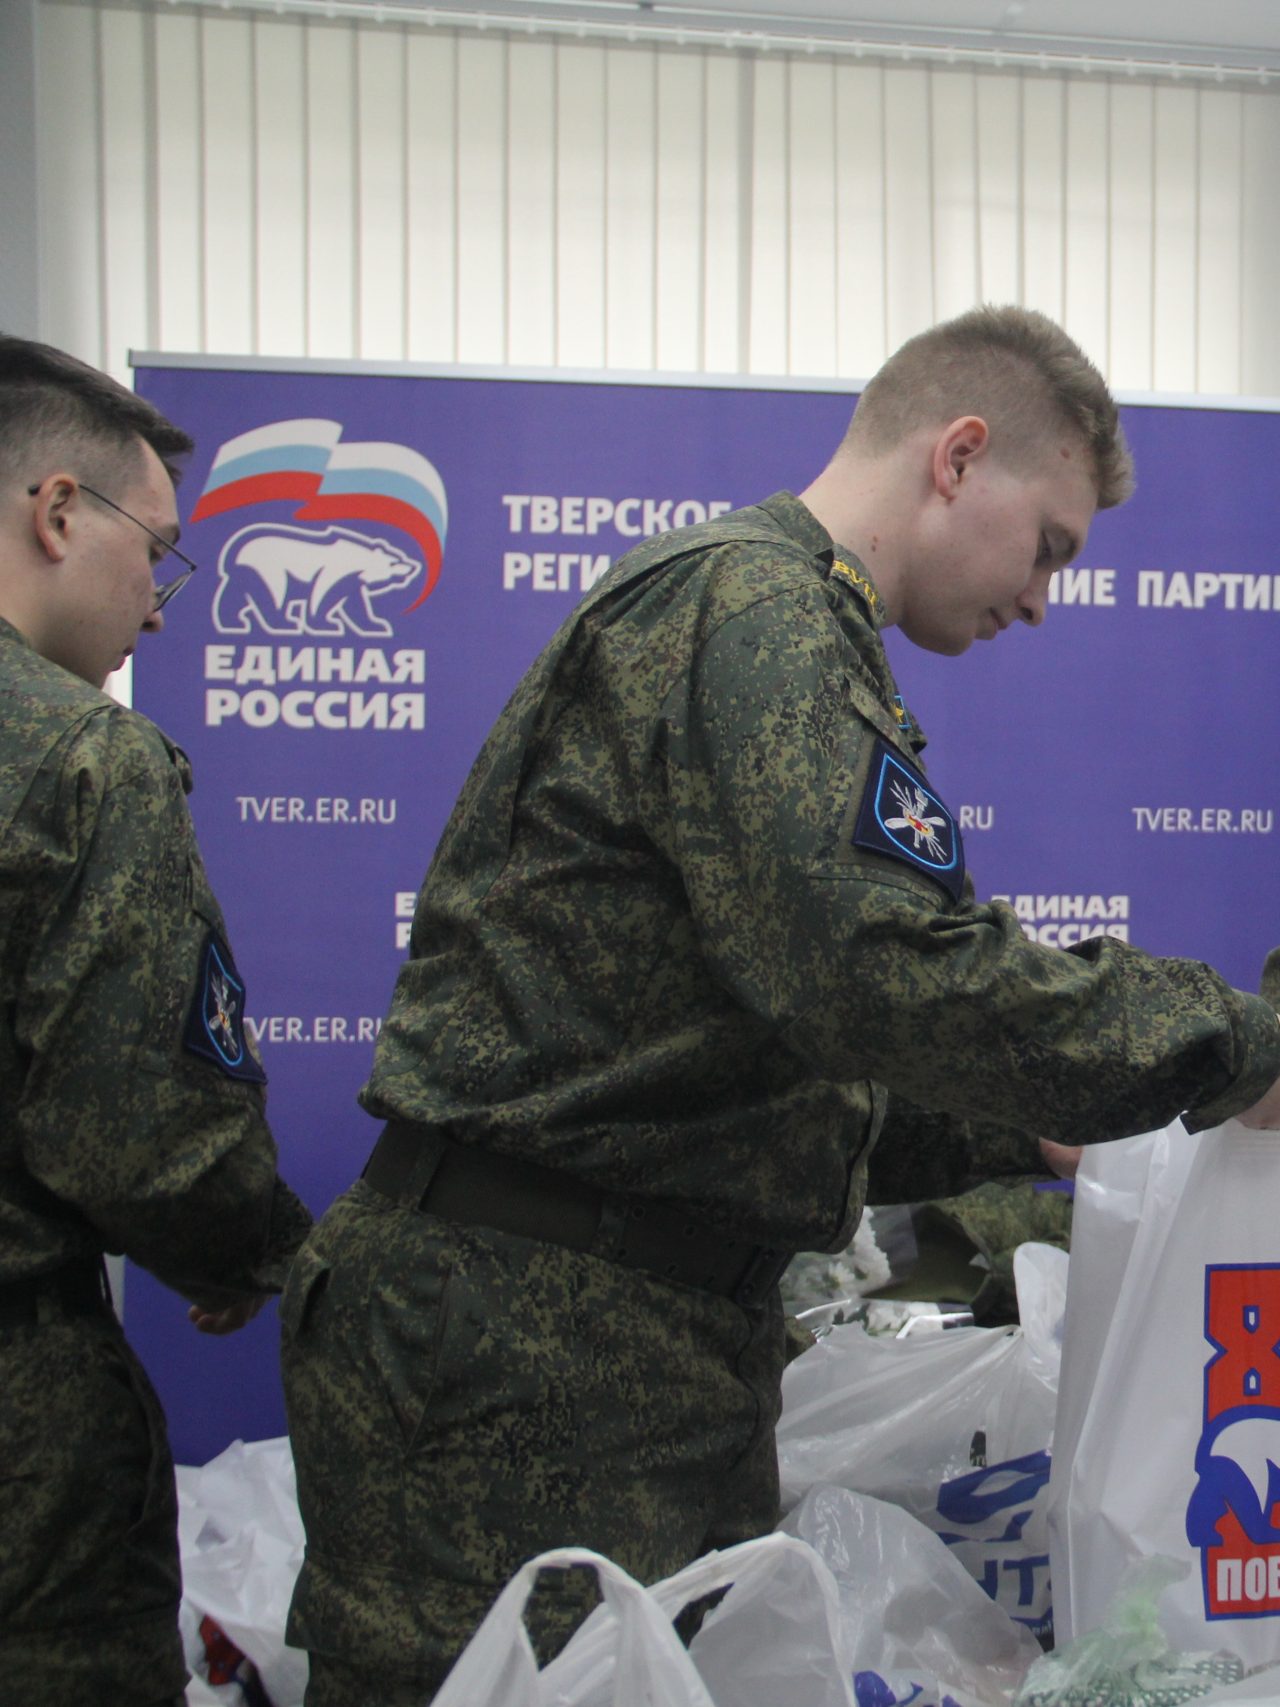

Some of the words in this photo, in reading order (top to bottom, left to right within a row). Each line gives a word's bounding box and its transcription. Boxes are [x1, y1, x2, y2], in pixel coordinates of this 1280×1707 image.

[205, 645, 426, 686] ЕДИНАЯ
[206, 689, 426, 730] РОССИЯ
[235, 796, 397, 824] TVER.ER.RU
[1132, 807, 1273, 834] TVER.ER.RU
[243, 1017, 382, 1043] VER.ER.R
